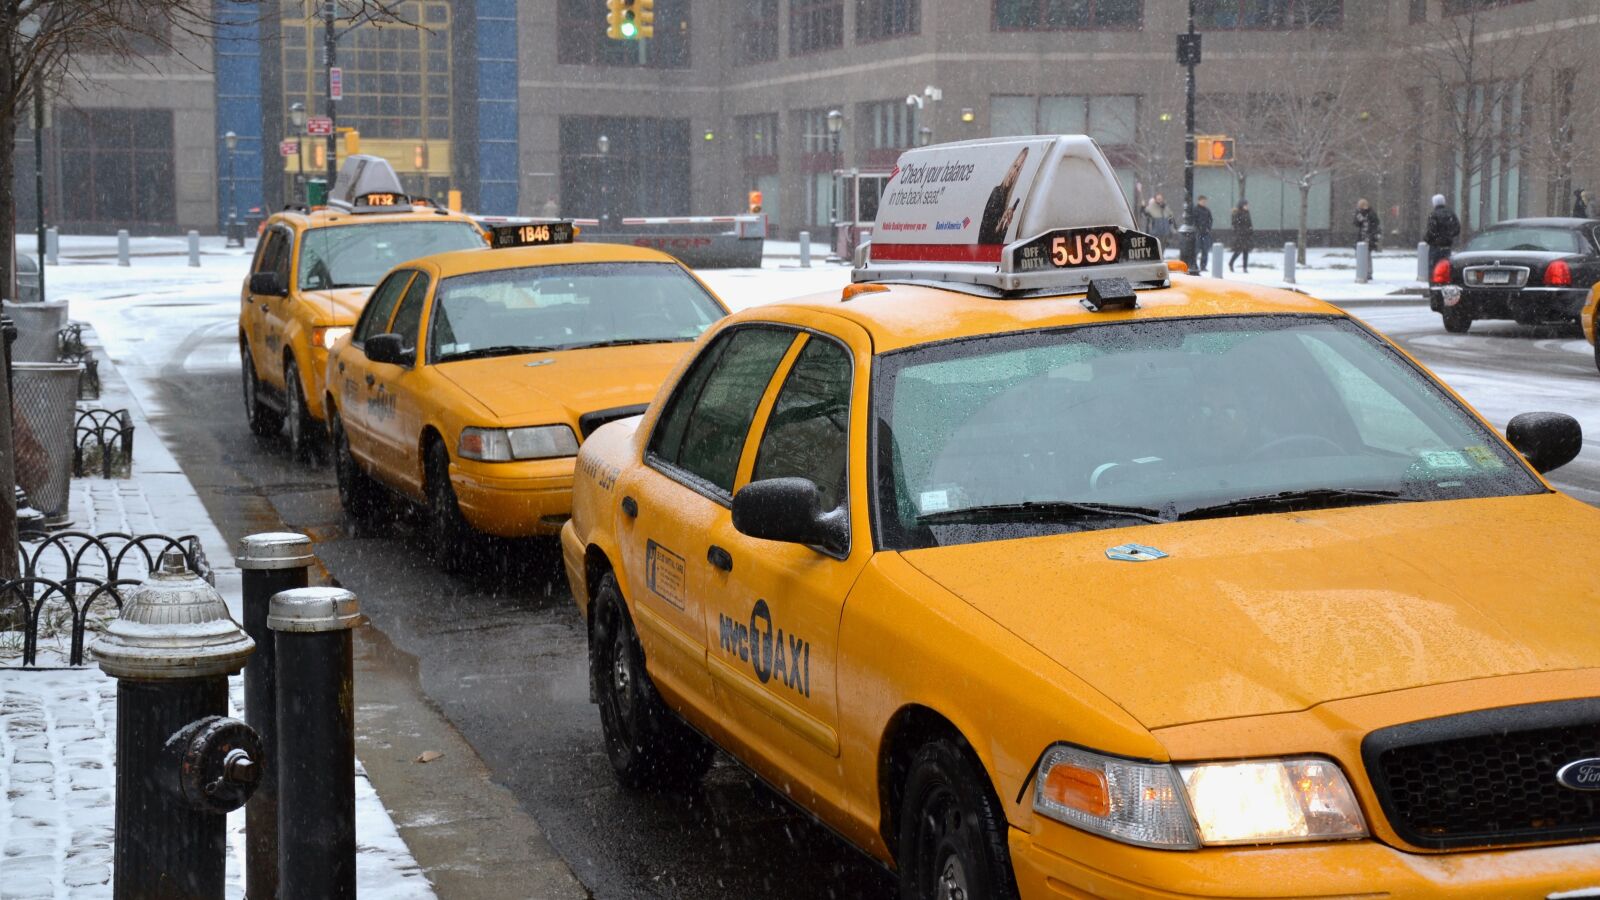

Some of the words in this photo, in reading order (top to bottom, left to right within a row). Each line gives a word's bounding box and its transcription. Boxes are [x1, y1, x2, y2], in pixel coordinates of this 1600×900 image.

[920, 165, 945, 188] your
[940, 160, 975, 182] balance
[367, 194, 394, 206] 7T32
[895, 188, 908, 205] the
[906, 187, 923, 205] back
[936, 221, 945, 230] Bank
[948, 221, 962, 230] America
[518, 225, 550, 243] 1B46
[634, 237, 712, 249] STOP
[1130, 237, 1147, 247] OFF
[1023, 246, 1039, 257] OFF
[1052, 232, 1117, 266] 5J39
[1128, 247, 1152, 259] DUTY
[1020, 256, 1044, 269] DUTY
[719, 612, 749, 663] NYC
[750, 600, 810, 699] TAXI
